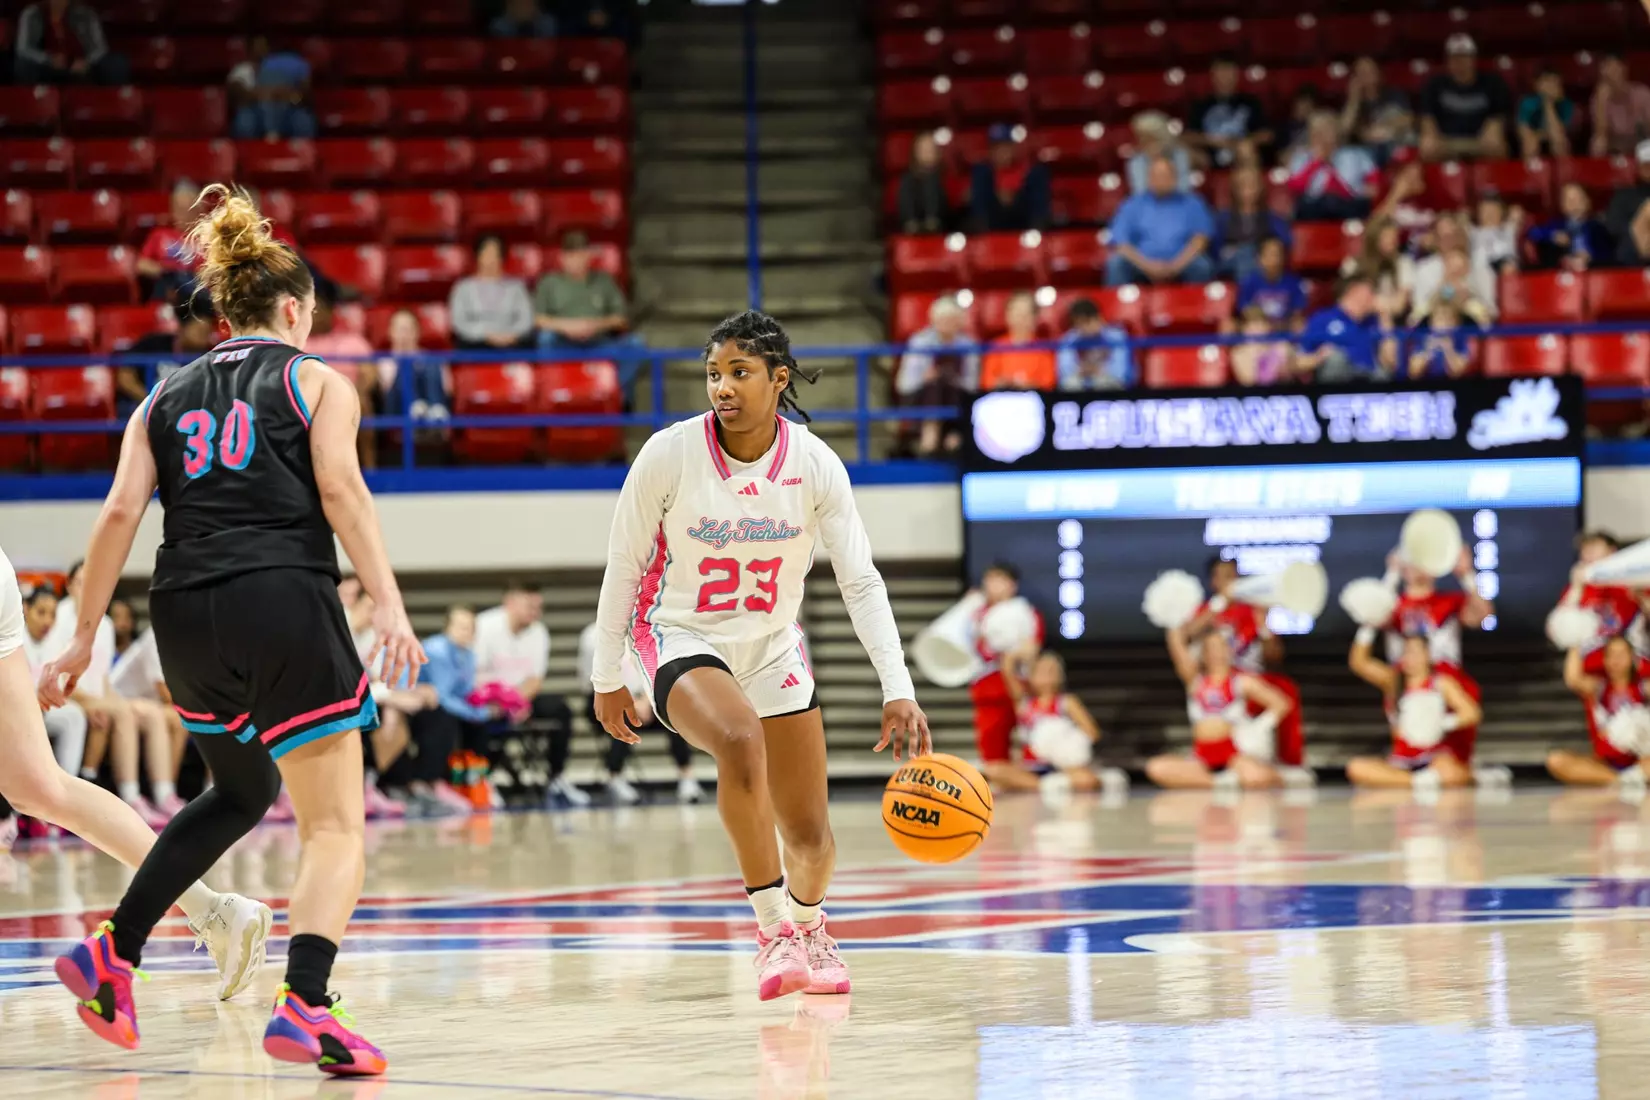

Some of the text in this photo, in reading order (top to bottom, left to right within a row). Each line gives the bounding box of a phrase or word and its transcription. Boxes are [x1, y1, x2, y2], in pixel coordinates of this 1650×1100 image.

[176, 399, 256, 479] 30
[687, 517, 802, 550] Lady Techsters
[695, 556, 783, 614] 23
[896, 767, 962, 801] Wilson
[891, 800, 940, 827] NCAA
